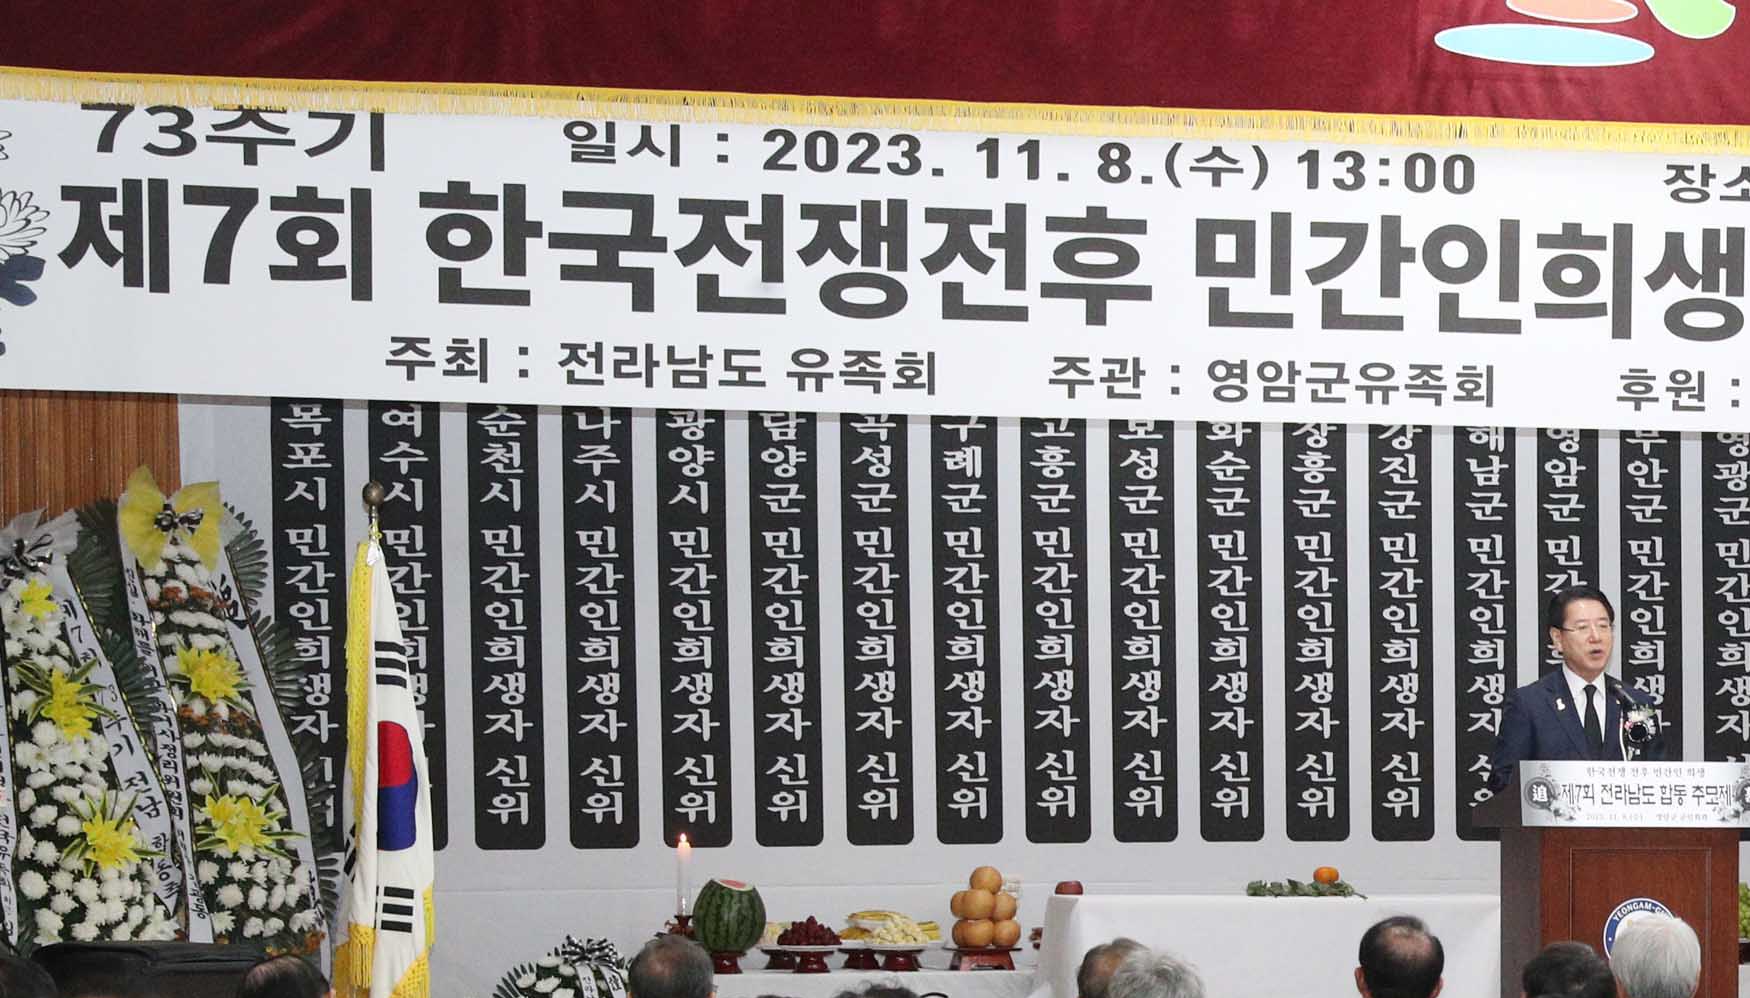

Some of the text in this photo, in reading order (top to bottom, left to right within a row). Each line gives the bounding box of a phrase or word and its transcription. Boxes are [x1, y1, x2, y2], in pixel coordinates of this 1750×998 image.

[563, 120, 681, 168] 일시
[763, 128, 944, 177] 2023.
[976, 137, 1069, 181] 11.
[1097, 142, 1268, 190] 8.(수)
[1297, 149, 1475, 194] 13:00
[57, 177, 373, 302] 제7회
[418, 180, 1152, 326] 한국전쟁전후
[385, 336, 488, 383] 주최
[558, 340, 766, 389] 전라남도
[786, 348, 937, 396] 유족회
[1048, 356, 1146, 399] 주관
[1207, 359, 1495, 407] 영암군유족회
[1617, 368, 1706, 412] 후원
[280, 402, 333, 511] 목포시
[379, 403, 429, 512] 여수시
[477, 405, 534, 825] 순천시 민간인희생자 신위
[572, 407, 628, 825] 나주시 민간인희생자 신위
[665, 409, 721, 824] 광양시 민간인희생자 신위
[759, 411, 812, 823] 담양군 민간인희생자 신위
[852, 526, 903, 740] 민간인희생자
[942, 526, 993, 739] 민간인희생자
[1031, 526, 1081, 738] 민간인희생자
[1119, 527, 1169, 738] 민간인희생자
[1207, 529, 1255, 739] 민간인희생자
[1293, 531, 1341, 739] 민간인희생자
[1378, 532, 1425, 740] 민간인희생자
[1626, 535, 1672, 741] 민간인희생
[857, 751, 900, 821] 신위
[946, 750, 990, 820] 신위
[1035, 749, 1078, 818] 신위
[1123, 749, 1165, 818] 신위
[1210, 750, 1251, 819] 신위
[1295, 751, 1337, 819] 신위
[1381, 751, 1422, 819] 신위
[1560, 784, 1732, 807] 제7회 전라남도 합동 추모제
